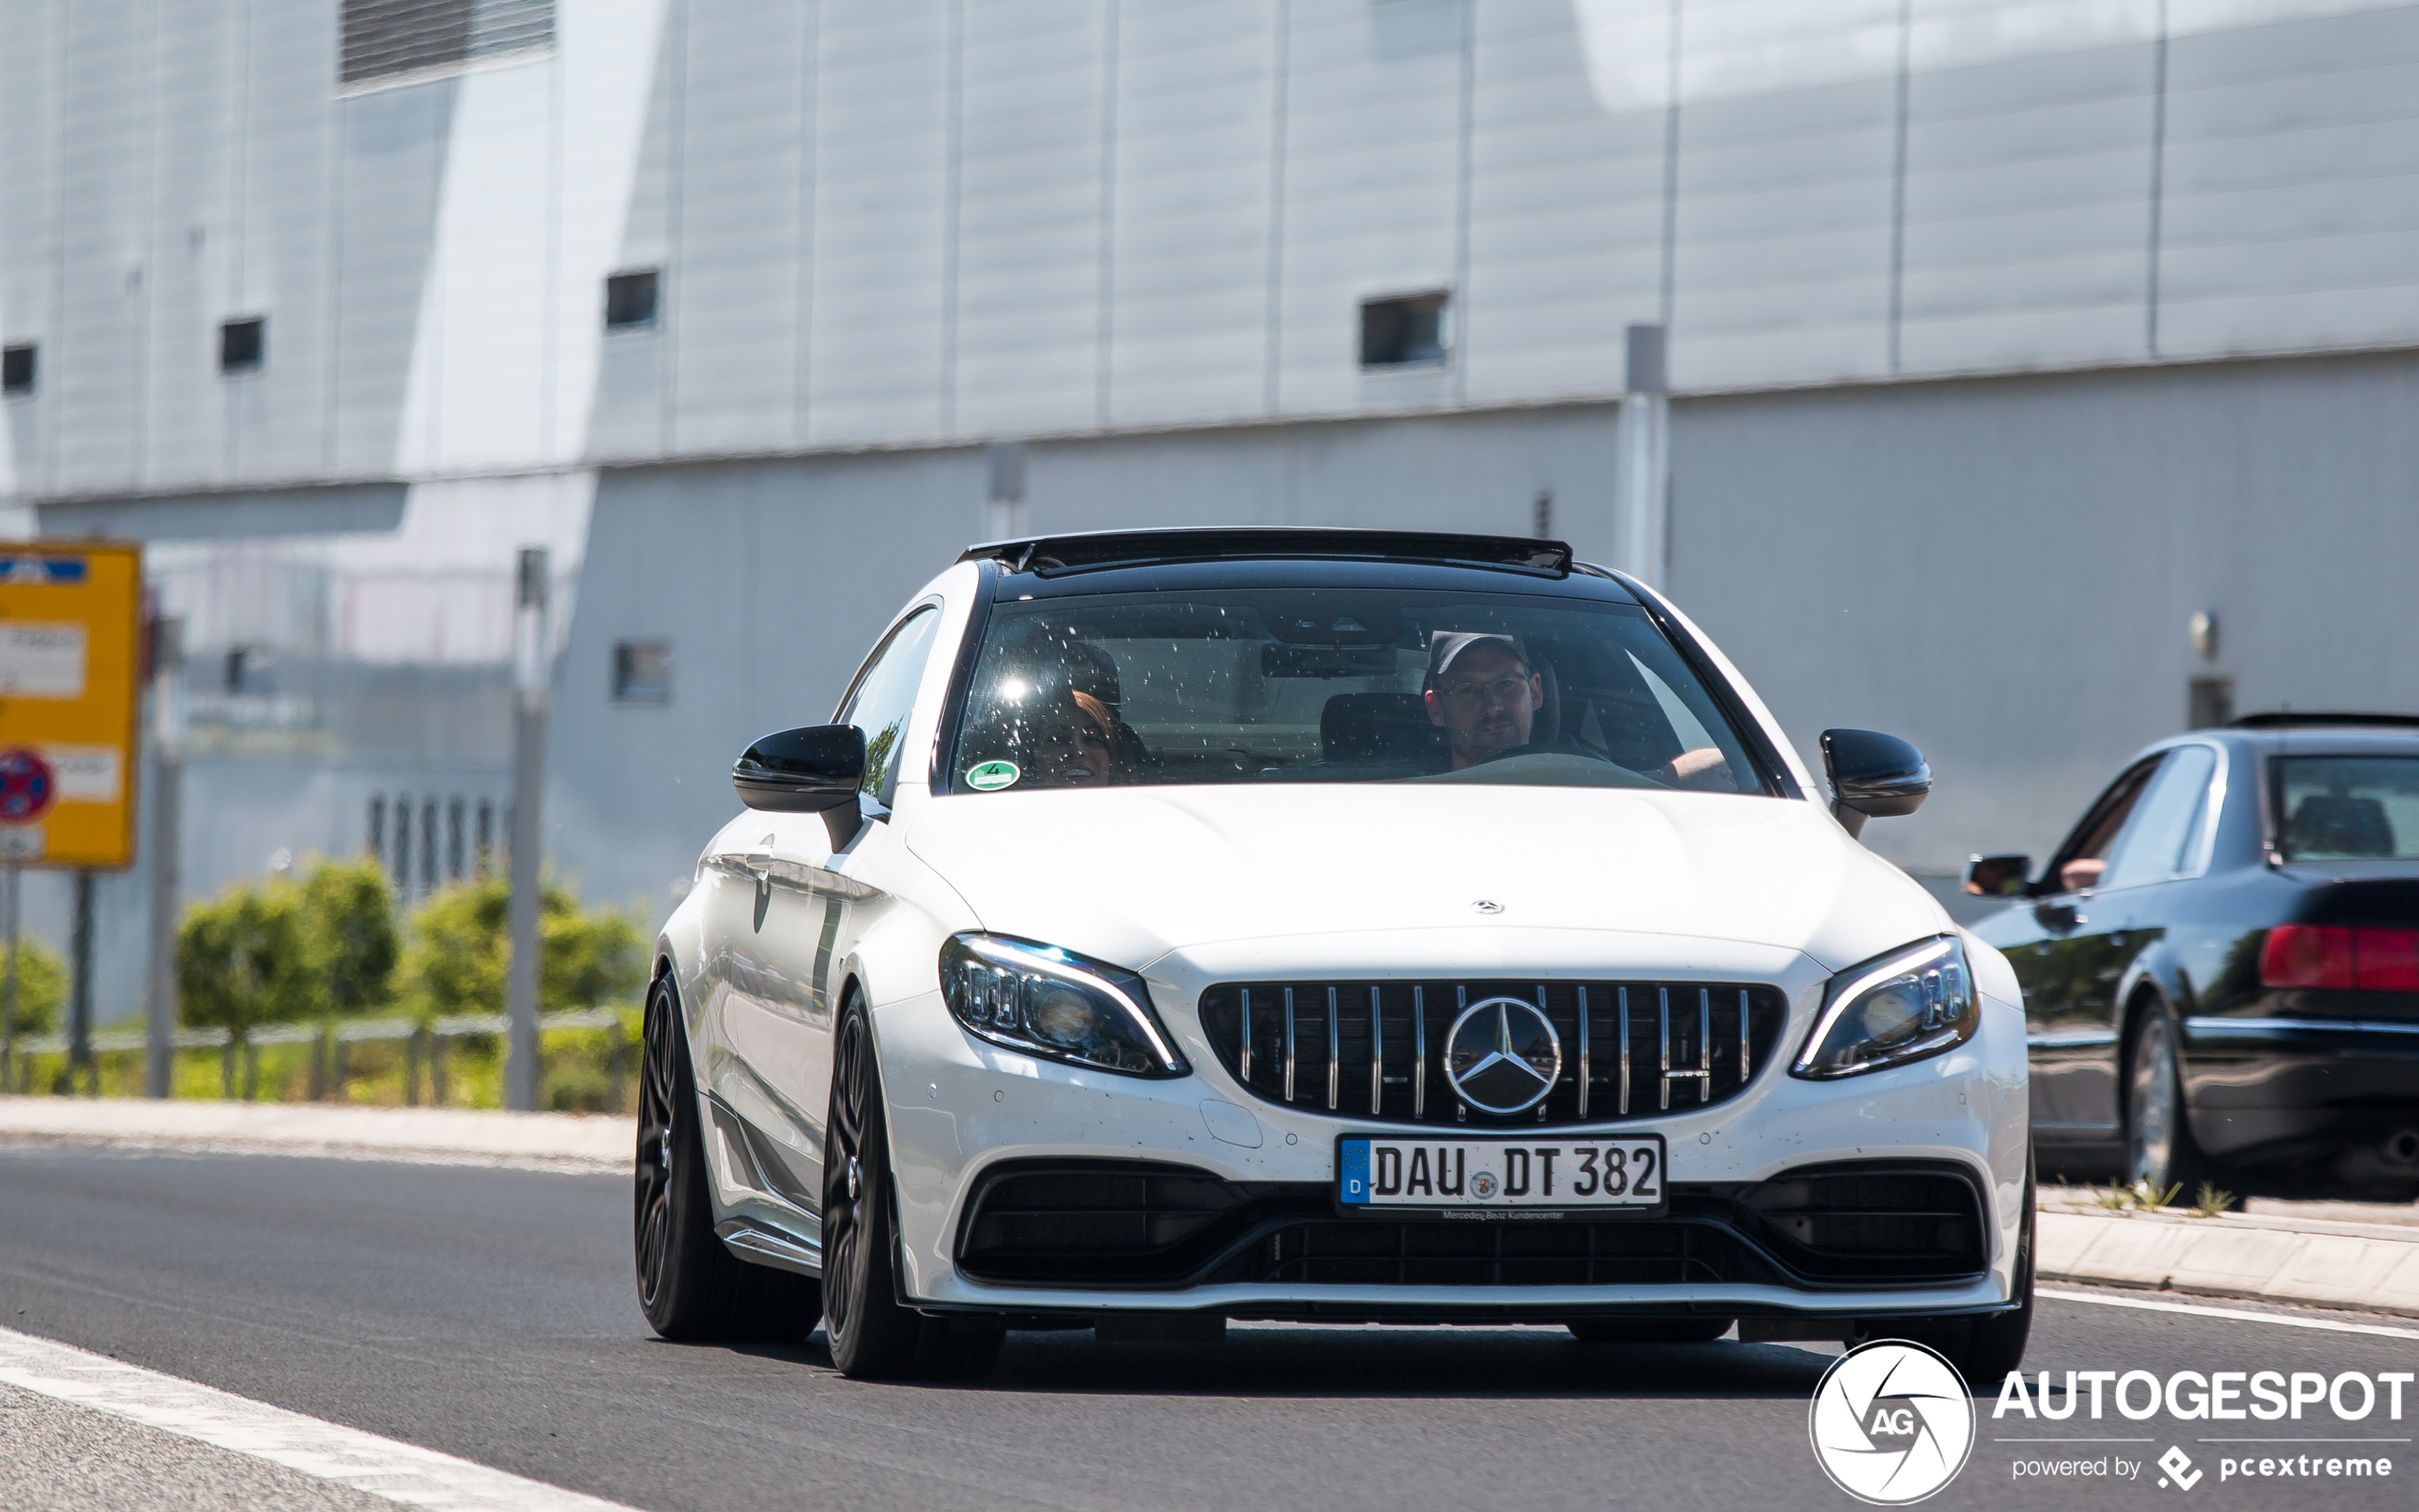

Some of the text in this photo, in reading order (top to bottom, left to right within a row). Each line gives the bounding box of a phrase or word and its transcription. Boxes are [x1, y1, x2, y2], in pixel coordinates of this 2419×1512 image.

[987, 764, 1000, 775] 4
[1375, 1147, 1658, 1197] DAU DT 382
[1349, 1179, 1361, 1194] D
[1443, 1210, 1565, 1220] Mercedes-Benz Kundencenter
